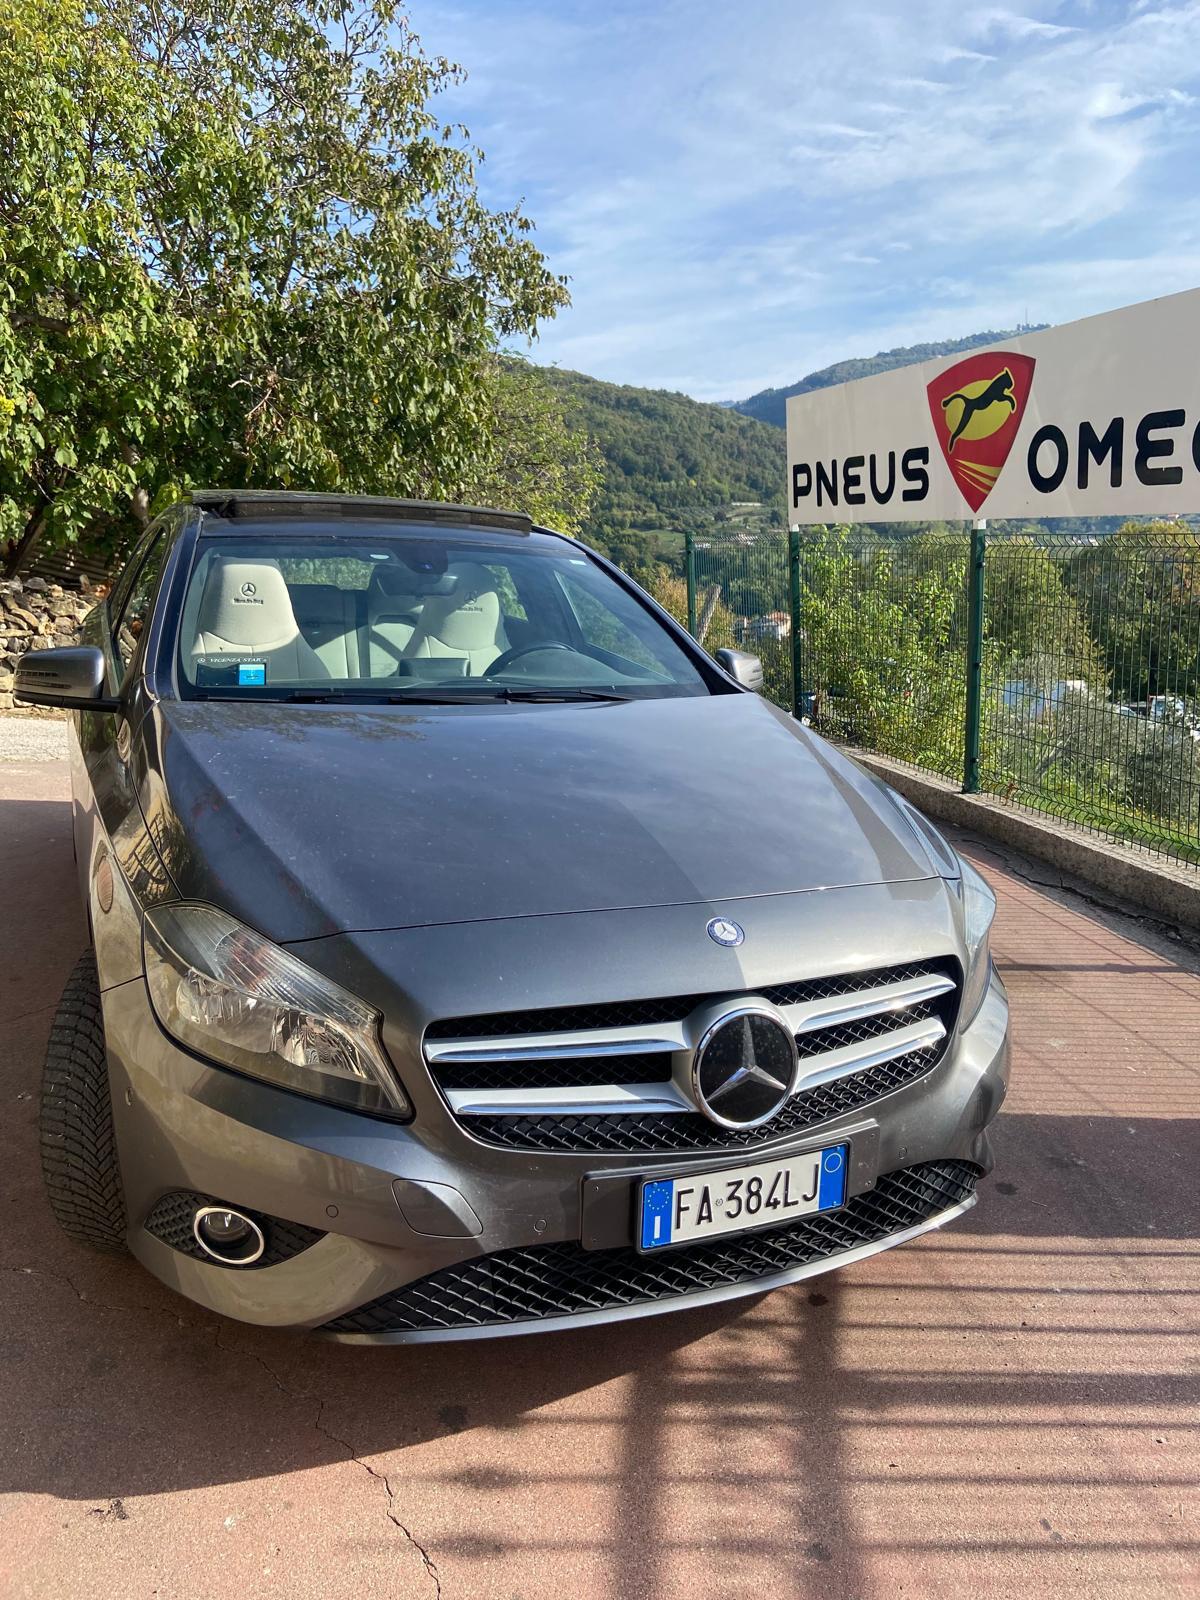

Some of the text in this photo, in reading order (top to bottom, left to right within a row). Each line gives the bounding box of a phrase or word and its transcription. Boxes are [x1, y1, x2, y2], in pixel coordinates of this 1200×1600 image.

[792, 408, 1200, 508] PNEUS OME
[674, 1163, 820, 1230] FA 384LJ
